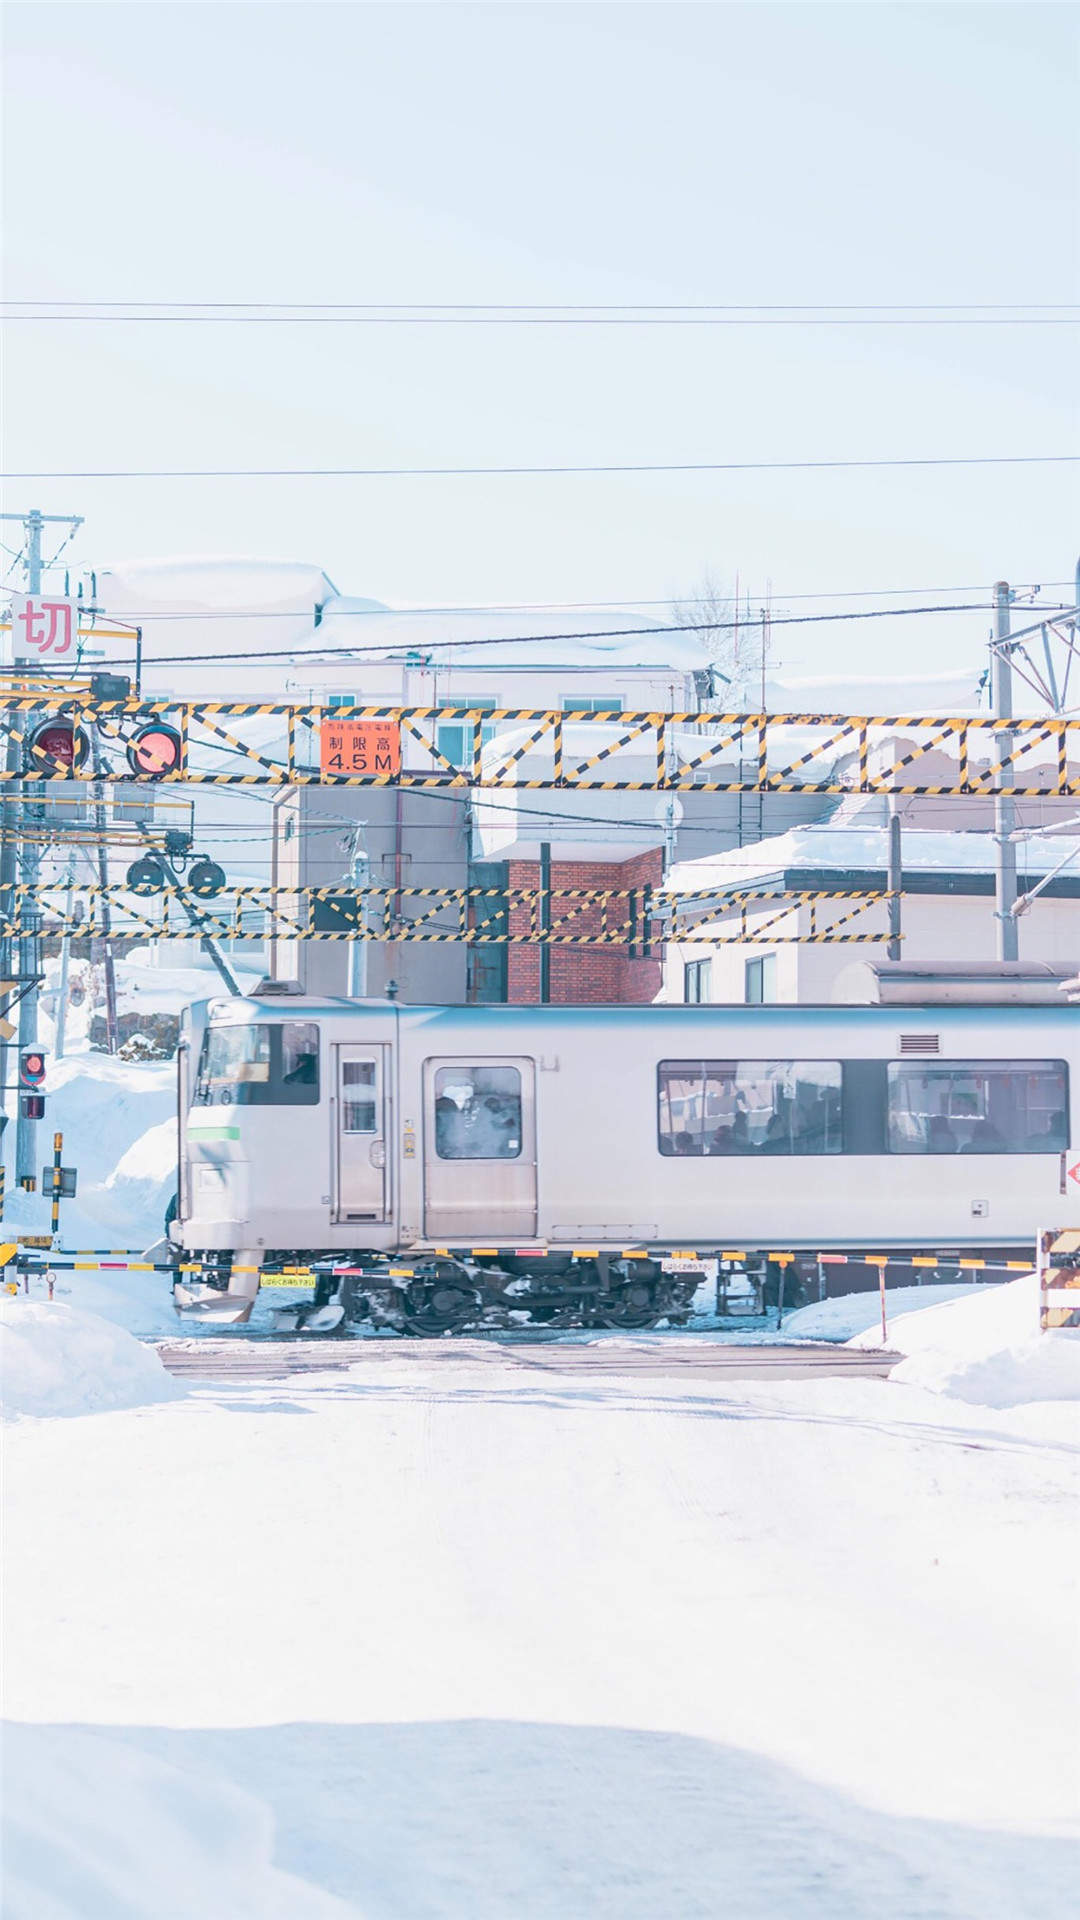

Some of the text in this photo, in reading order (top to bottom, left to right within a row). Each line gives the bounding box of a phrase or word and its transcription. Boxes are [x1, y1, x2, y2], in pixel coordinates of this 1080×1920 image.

[18, 600, 71, 653] 切
[329, 736, 391, 751] 制限高
